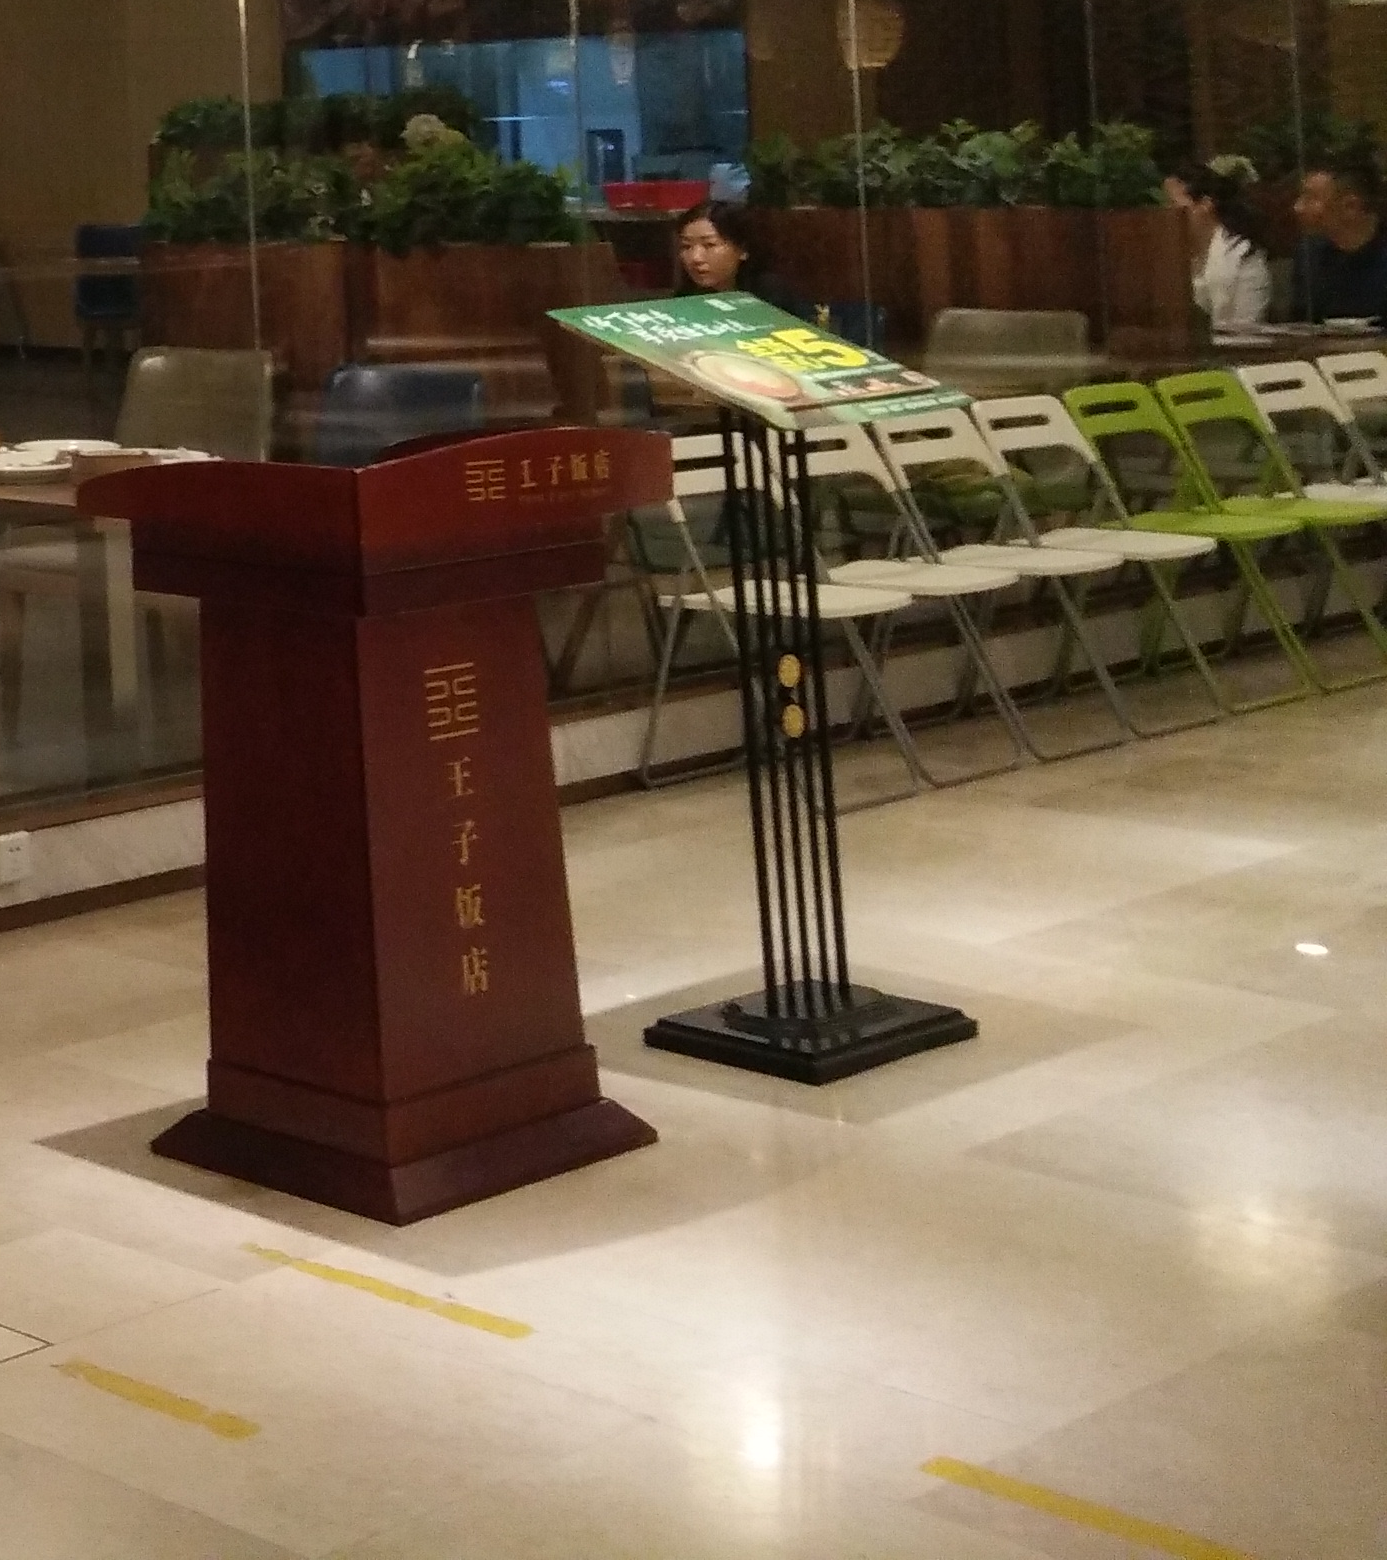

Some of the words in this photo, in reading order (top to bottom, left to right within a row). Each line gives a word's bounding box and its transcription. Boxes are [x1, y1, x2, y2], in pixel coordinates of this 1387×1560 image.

[770, 328, 870, 367] 5
[519, 449, 611, 489] 王子饭店
[445, 755, 491, 997] 王子饭店
